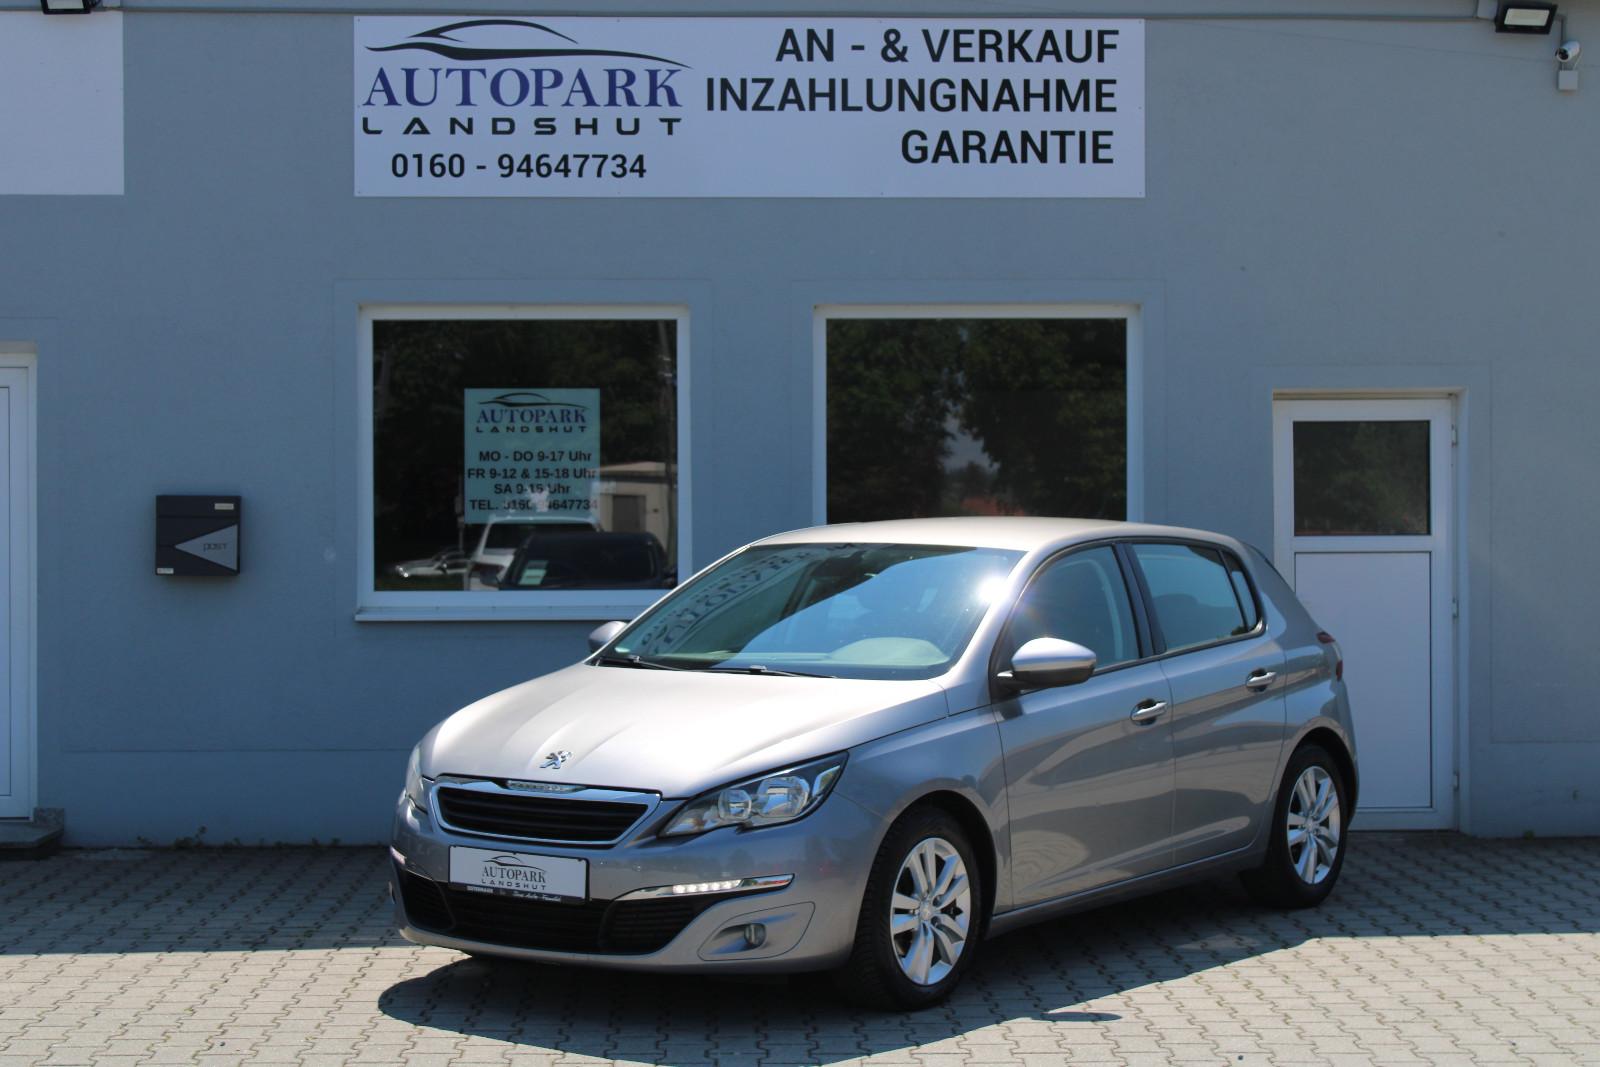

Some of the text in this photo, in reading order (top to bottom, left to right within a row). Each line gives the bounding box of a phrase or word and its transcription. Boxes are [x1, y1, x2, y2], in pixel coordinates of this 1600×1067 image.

[776, 30, 834, 62] AN
[881, 29, 909, 63] &
[922, 30, 1119, 63] VERKAUF
[364, 68, 681, 107] AUTOPARK
[706, 78, 1117, 112] INZAHLUNGNAHME
[363, 117, 681, 136] LANDSHUT
[901, 130, 1114, 164] GARANTIE
[391, 153, 465, 178] 0160
[497, 153, 647, 178] 94647734
[477, 409, 587, 424] AUTOPARK
[479, 450, 501, 462] MO
[513, 450, 534, 462] DO
[537, 450, 565, 462] 9-17
[568, 450, 592, 462] Uhr
[467, 467, 597, 480] FR 9-12 & 15-18 Uhr
[494, 483, 512, 495] SA
[548, 483, 571, 495] Uhr
[470, 499, 499, 510] TEL.
[482, 866, 546, 884] AUTOPARK
[481, 879, 547, 890] LANDSHUT
